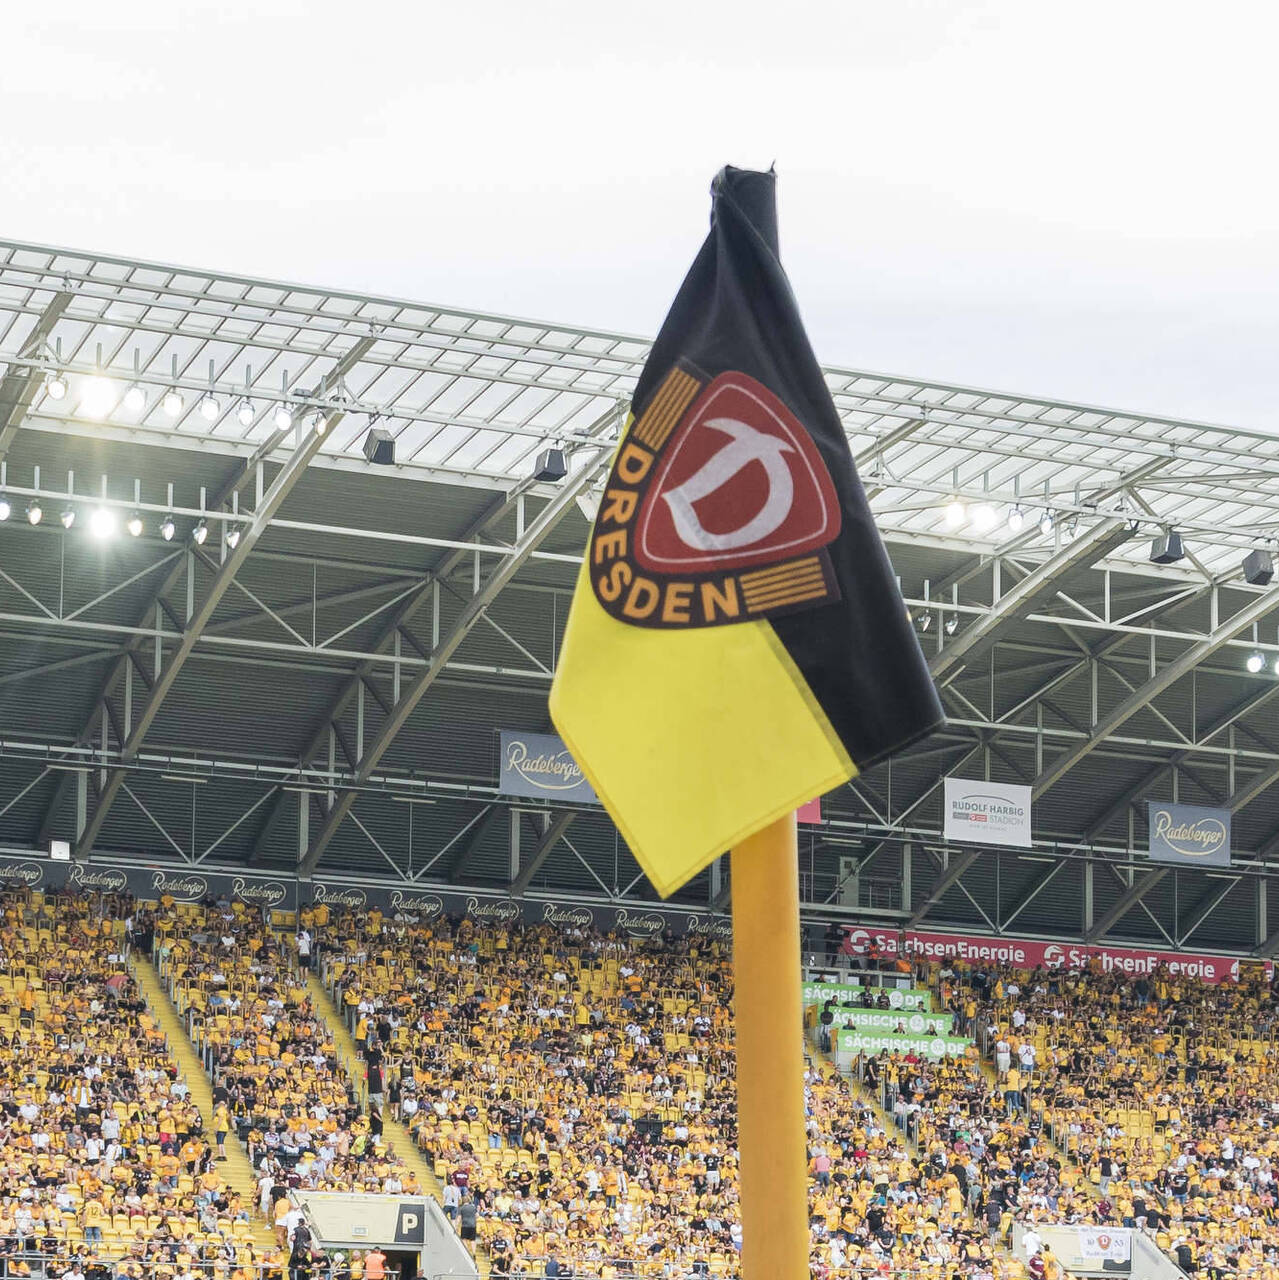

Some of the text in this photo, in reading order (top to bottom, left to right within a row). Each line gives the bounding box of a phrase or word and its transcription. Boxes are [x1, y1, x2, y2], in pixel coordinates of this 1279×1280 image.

[595, 442, 740, 623] DRESDEN
[952, 801, 1024, 816] RUDOLF HARBIG
[1155, 811, 1226, 853] Radeberger
[69, 864, 127, 892] Radeberger
[152, 871, 208, 900] Radeberger
[232, 877, 287, 906] Radeberger
[313, 883, 367, 911] Radeberger
[390, 890, 443, 917] Radeberger
[542, 902, 593, 930] Radeberger
[615, 908, 666, 937] Radeberger
[832, 1010, 909, 1029] ÄCHSISCHE
[845, 1033, 928, 1053] SÄCHSISCHE
[402, 1213, 419, 1235] P
